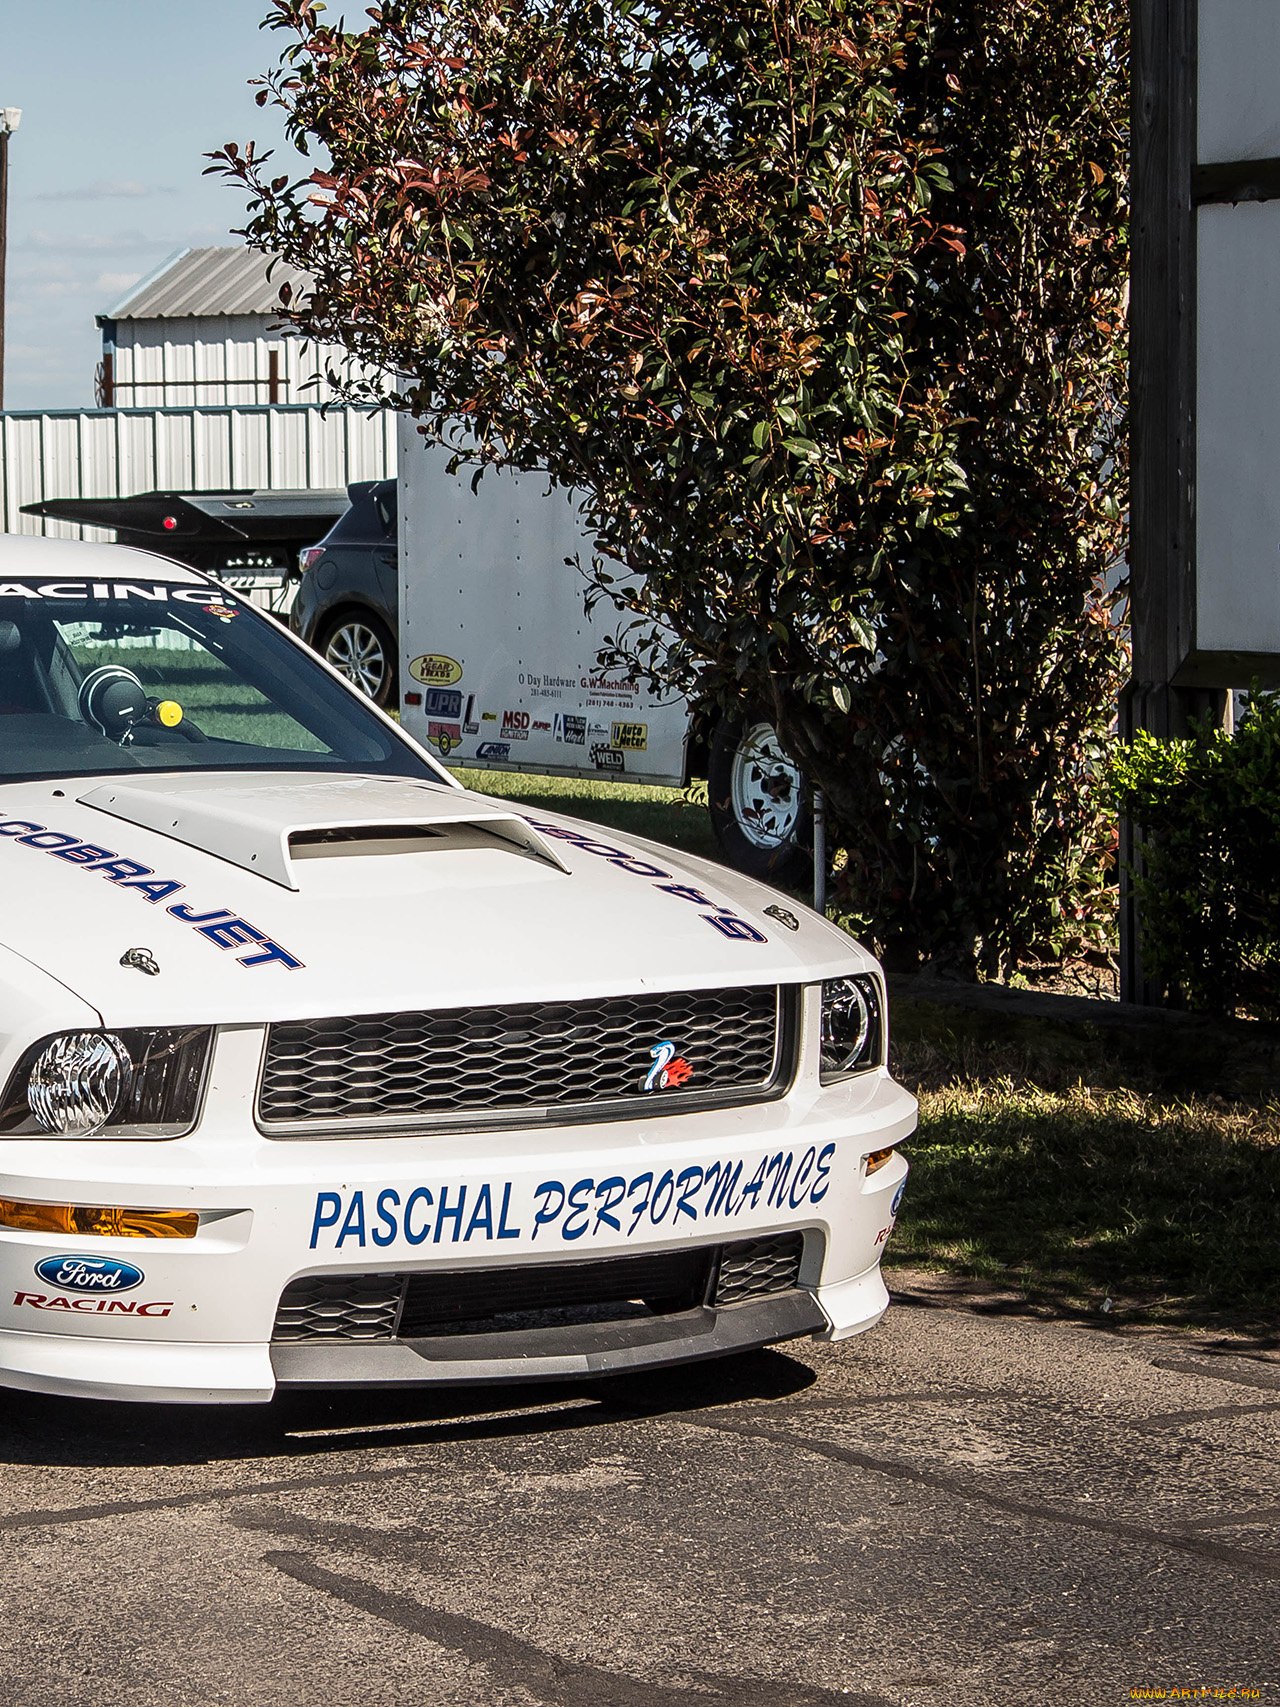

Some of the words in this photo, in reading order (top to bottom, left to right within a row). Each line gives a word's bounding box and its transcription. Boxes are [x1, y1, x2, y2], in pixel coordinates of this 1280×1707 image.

[425, 663, 450, 671] GEAR
[527, 674, 541, 688] Day
[543, 675, 576, 688] Hardware
[427, 692, 460, 713] UPR
[502, 710, 531, 730] MSD
[620, 735, 646, 747] Meter
[621, 725, 642, 737] Auto
[597, 752, 623, 764] WELD
[166, 902, 307, 970] JET
[309, 1181, 521, 1250] PASCHAL
[530, 1142, 837, 1241] PERFORMANCE
[57, 1260, 122, 1289] Ford
[13, 1290, 175, 1317] RACING
